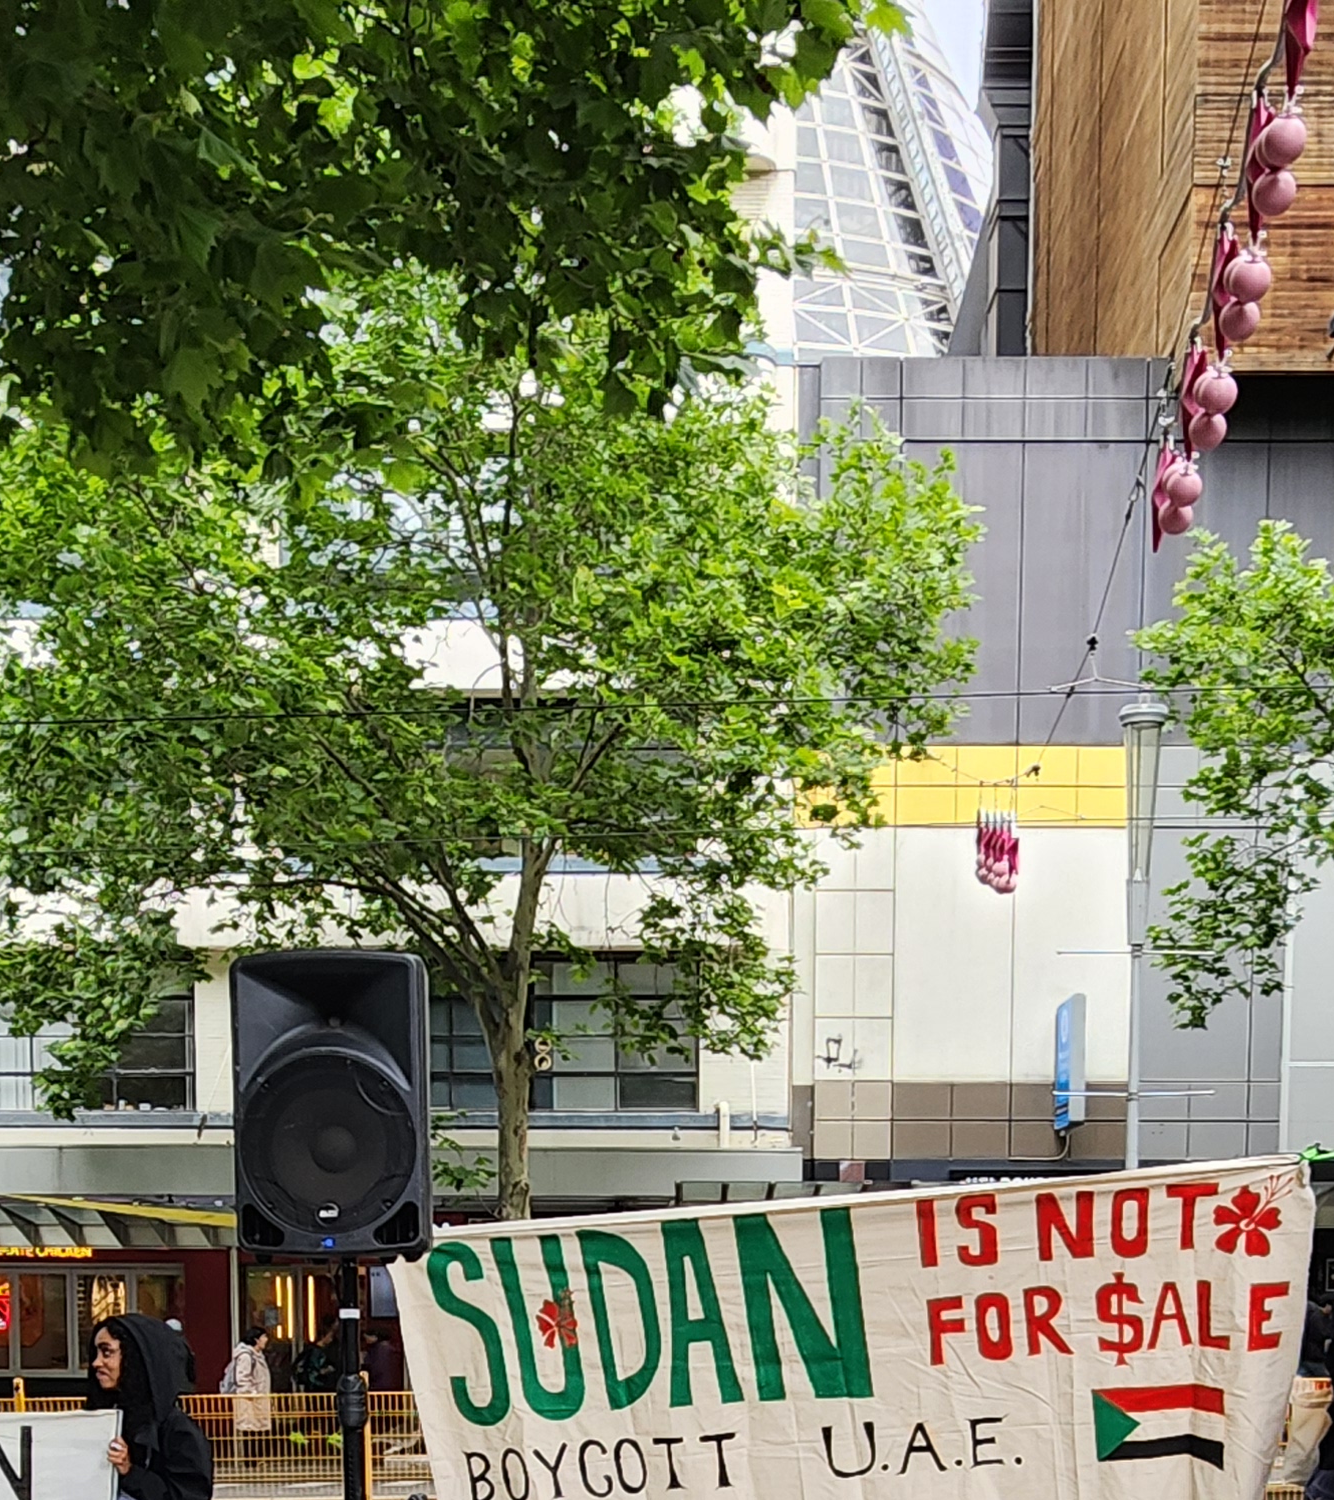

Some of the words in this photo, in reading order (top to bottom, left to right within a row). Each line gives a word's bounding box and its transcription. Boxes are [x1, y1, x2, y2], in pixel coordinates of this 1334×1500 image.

[915, 1192, 999, 1269] IS
[1034, 1181, 1220, 1262] NOT
[426, 1206, 874, 1427] SUDAN
[925, 1285, 1075, 1366] FOR
[1094, 1271, 1291, 1367] $ALE
[821, 1414, 1023, 1479] U.A.E.
